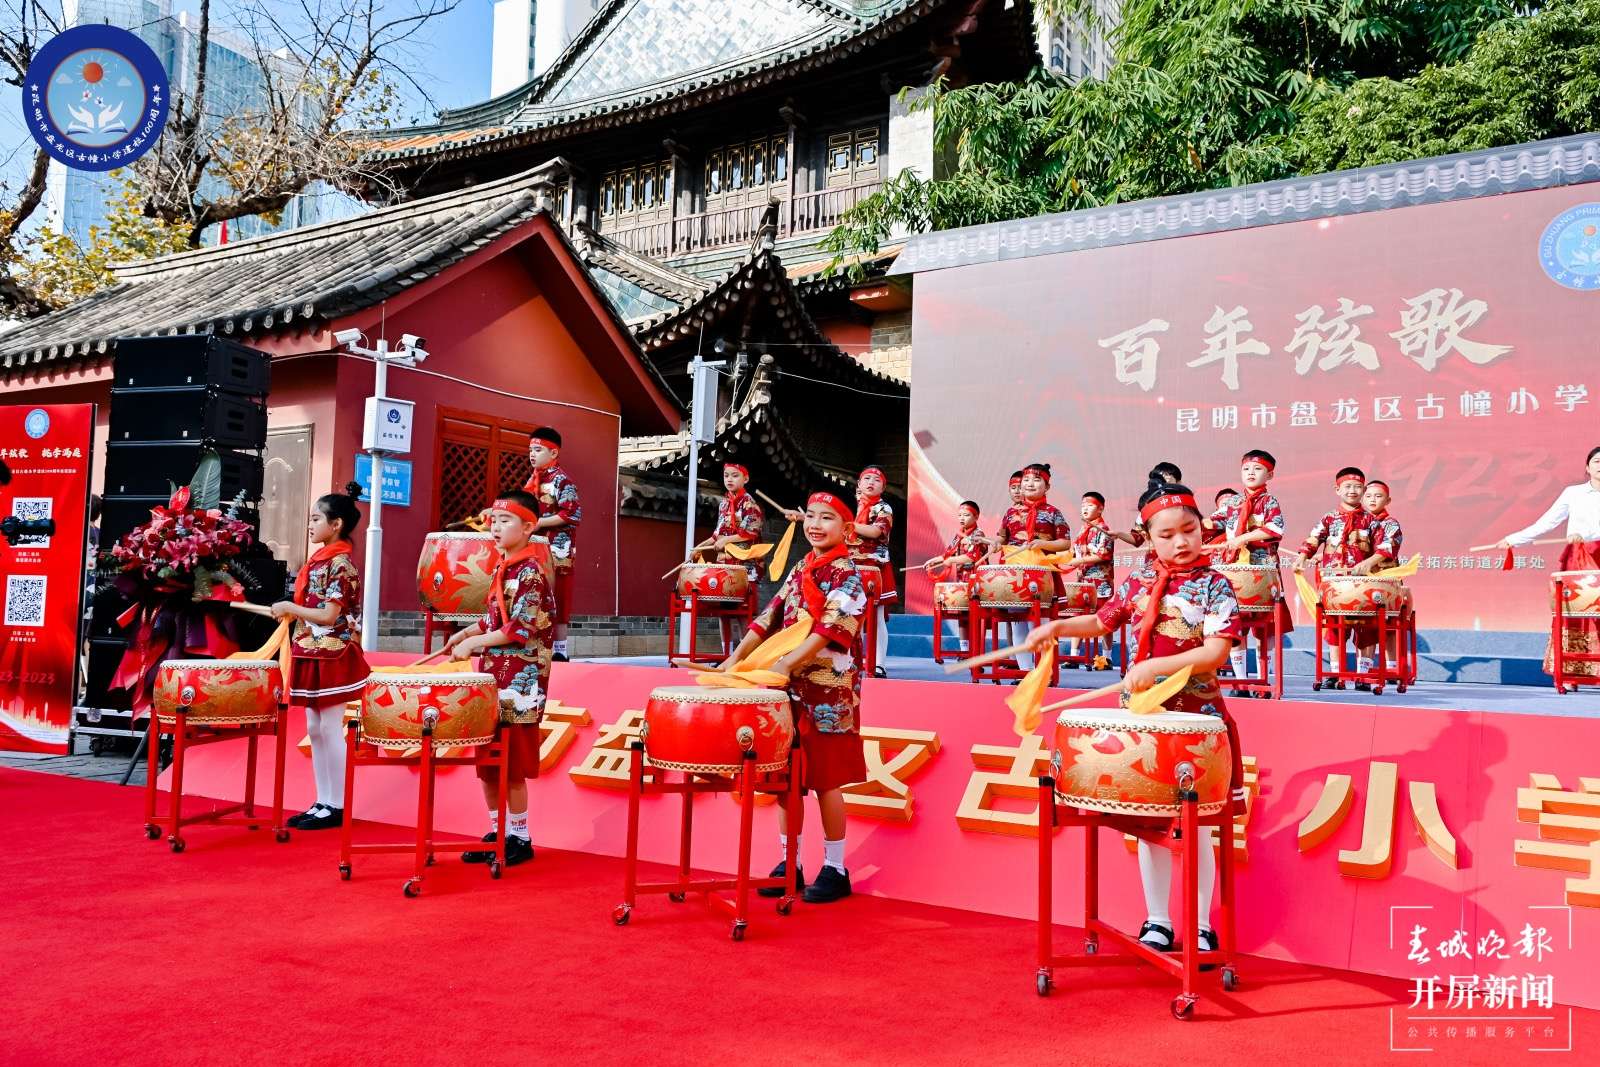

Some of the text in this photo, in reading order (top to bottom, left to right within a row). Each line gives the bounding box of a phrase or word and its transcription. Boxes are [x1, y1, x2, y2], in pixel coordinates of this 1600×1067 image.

[1097, 287, 1515, 392] 百年弦歌
[1174, 384, 1589, 433] 昆明市盘龙区古幢小学
[1160, 495, 1182, 507] 中国
